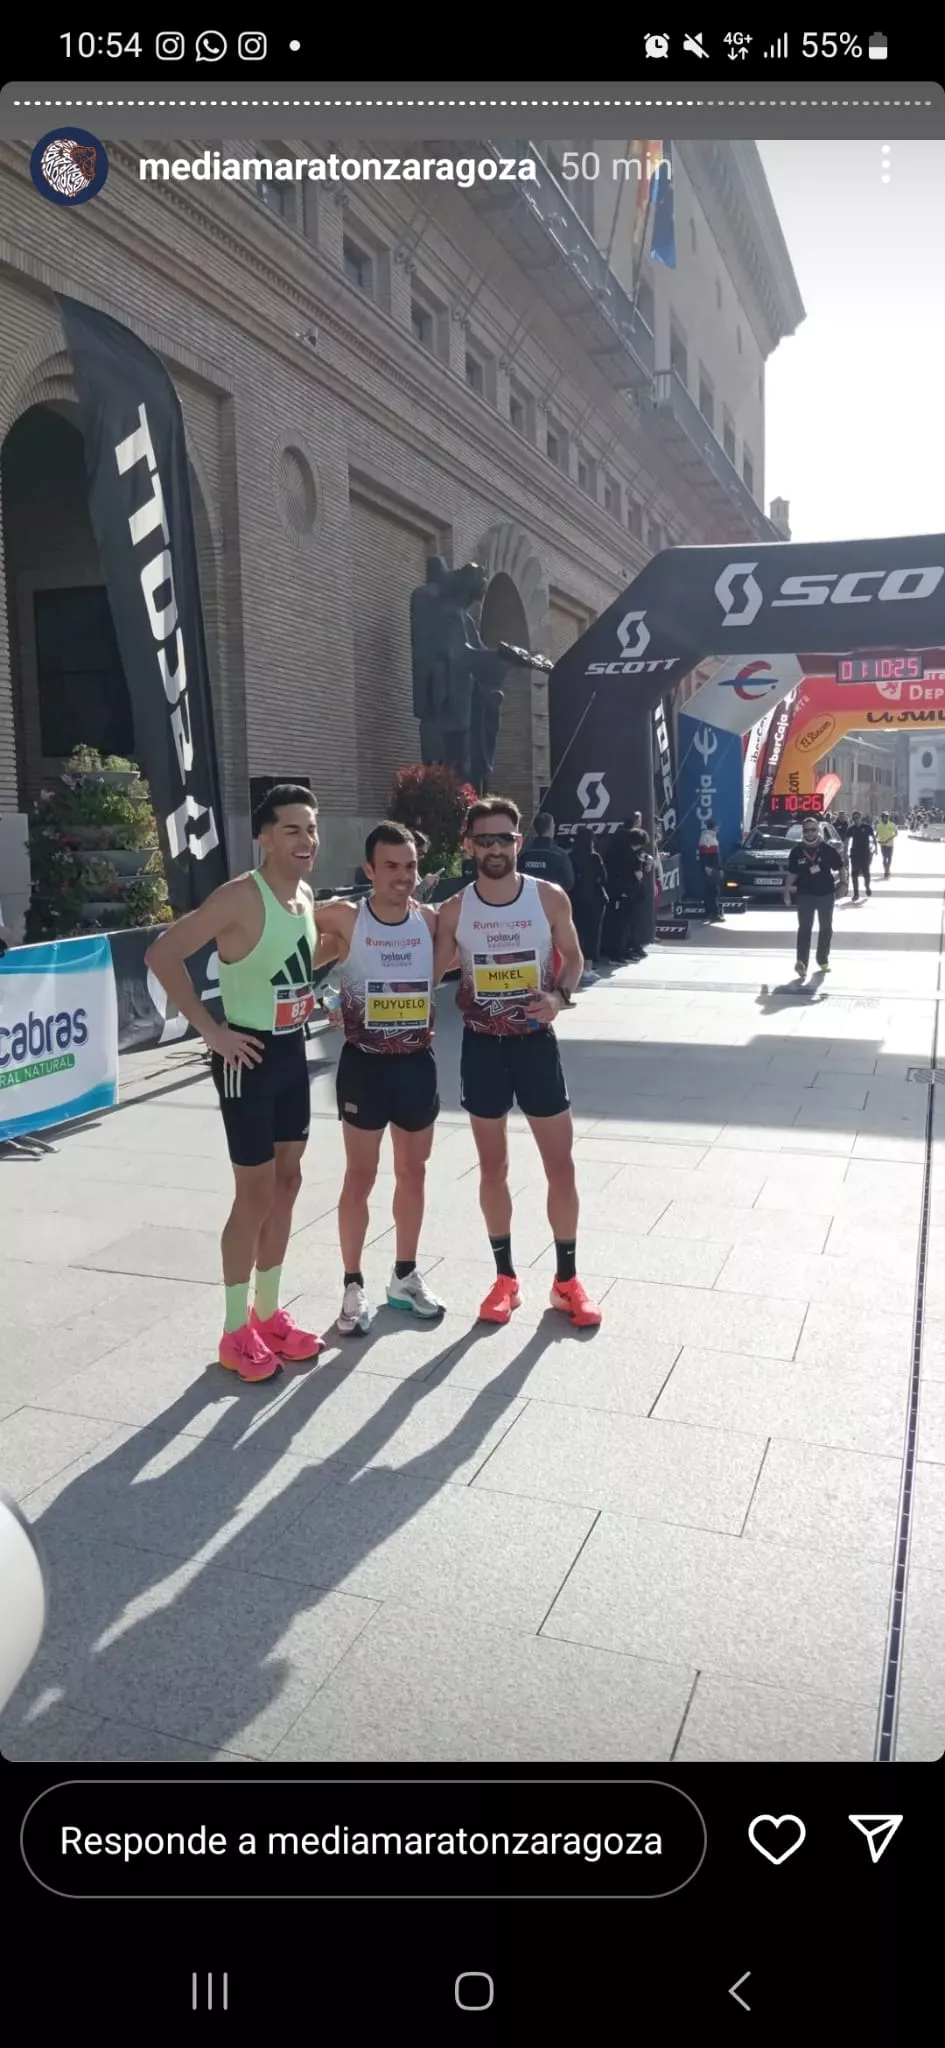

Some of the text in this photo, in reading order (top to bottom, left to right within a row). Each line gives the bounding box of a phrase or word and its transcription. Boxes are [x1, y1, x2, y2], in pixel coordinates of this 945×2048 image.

[584, 657, 681, 676] SCOTT
[487, 969, 524, 981] MIKEL
[291, 1000, 307, 1018] 82
[373, 999, 426, 1010] PUYUELO
[0, 1007, 88, 1066] cabras
[24, 1057, 74, 1080] NATURAL
